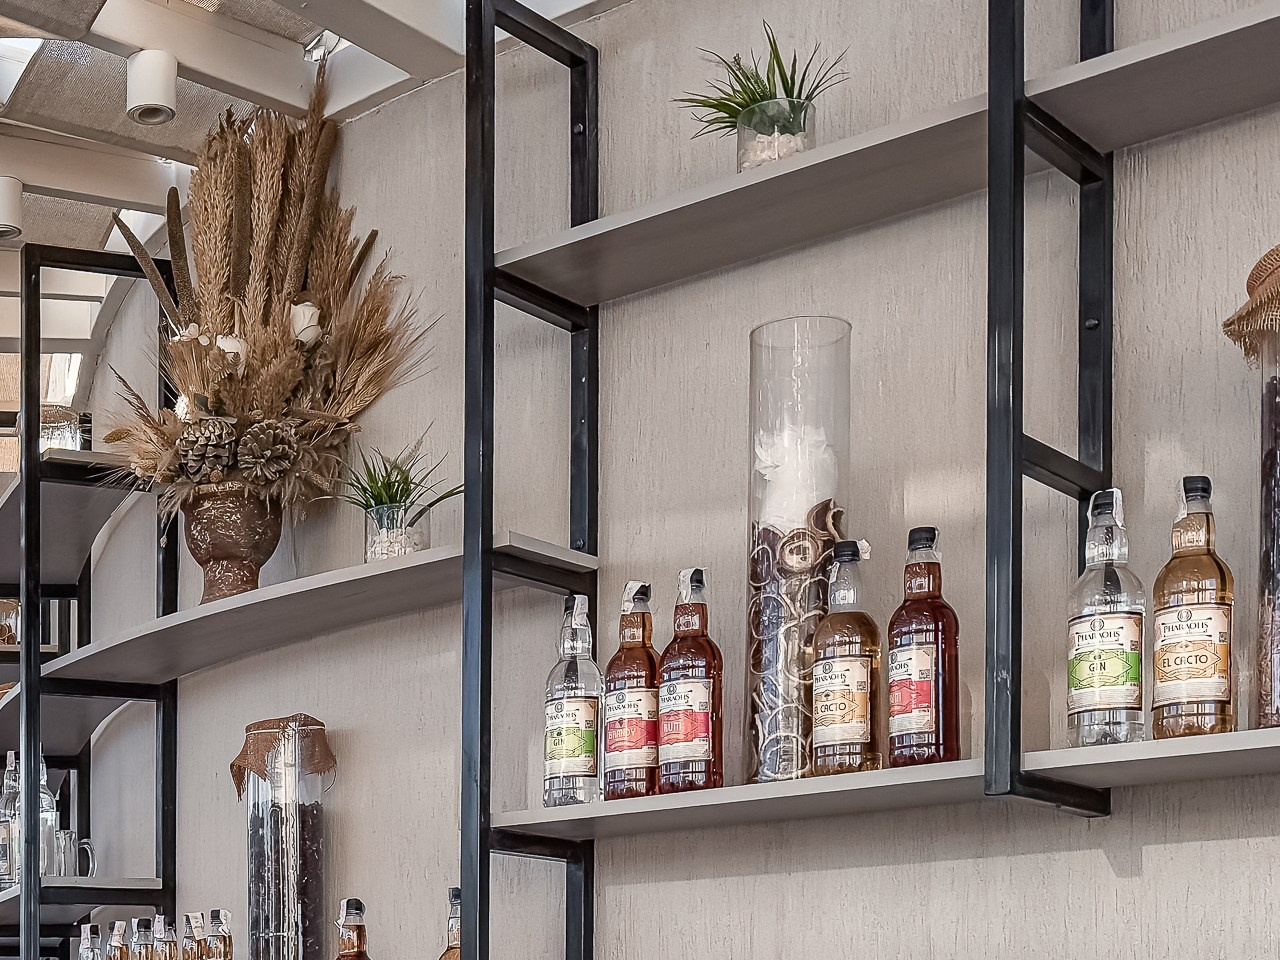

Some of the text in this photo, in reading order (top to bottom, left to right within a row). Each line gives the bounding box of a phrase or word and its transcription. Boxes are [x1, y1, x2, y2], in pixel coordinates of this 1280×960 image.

[1088, 661, 1106, 672] GIN
[1162, 654, 1209, 668] EL CACTO
[820, 702, 847, 713] CACTO
[663, 721, 683, 733] RUM
[608, 728, 636, 740] BRANDY
